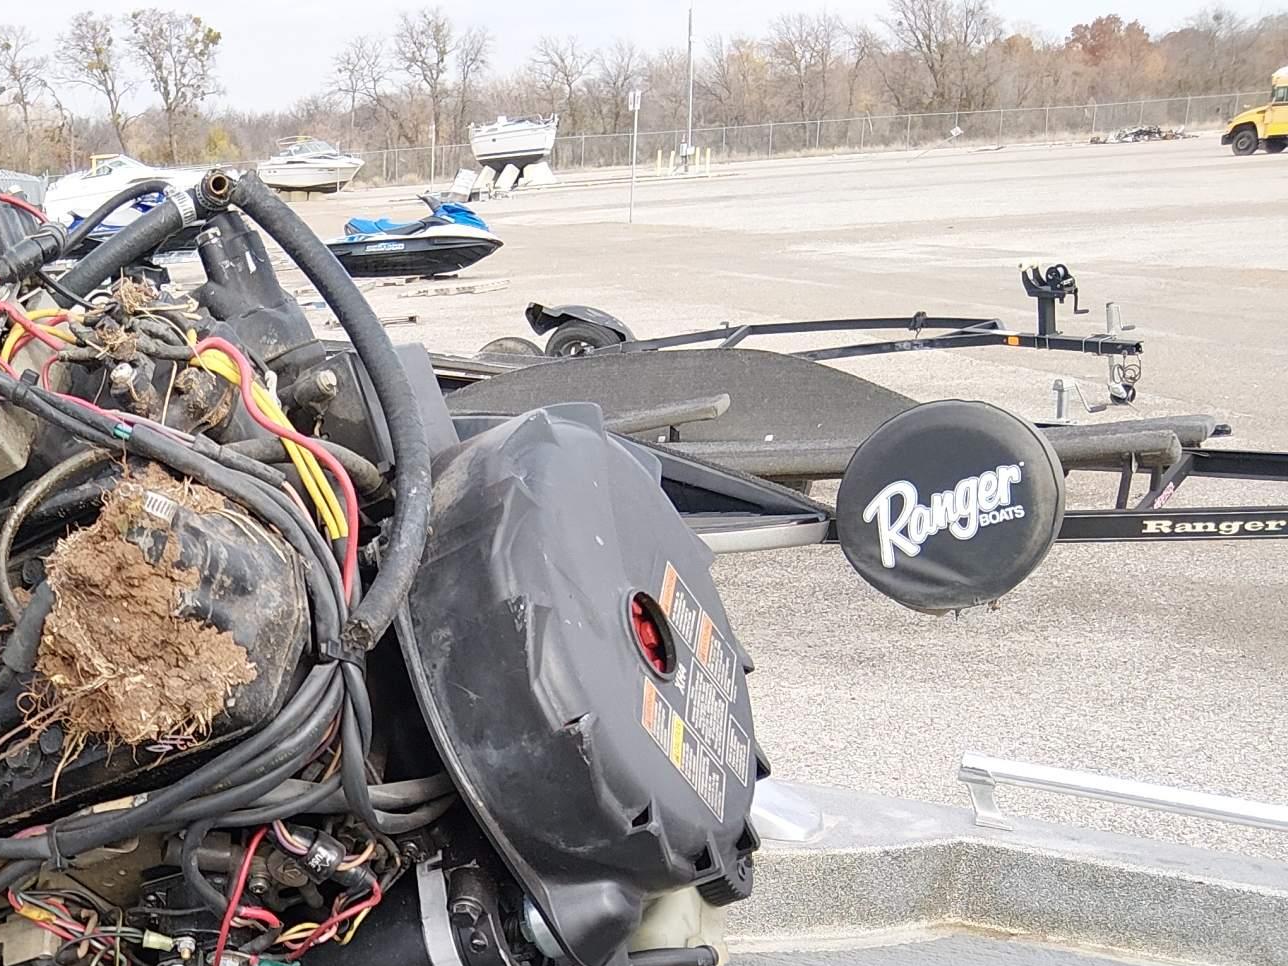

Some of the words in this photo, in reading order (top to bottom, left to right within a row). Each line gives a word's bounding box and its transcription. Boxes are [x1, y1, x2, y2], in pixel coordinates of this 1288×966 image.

[863, 464, 1022, 568] Ranger
[979, 505, 1025, 527] BOATS
[1141, 519, 1287, 535] Ranger
